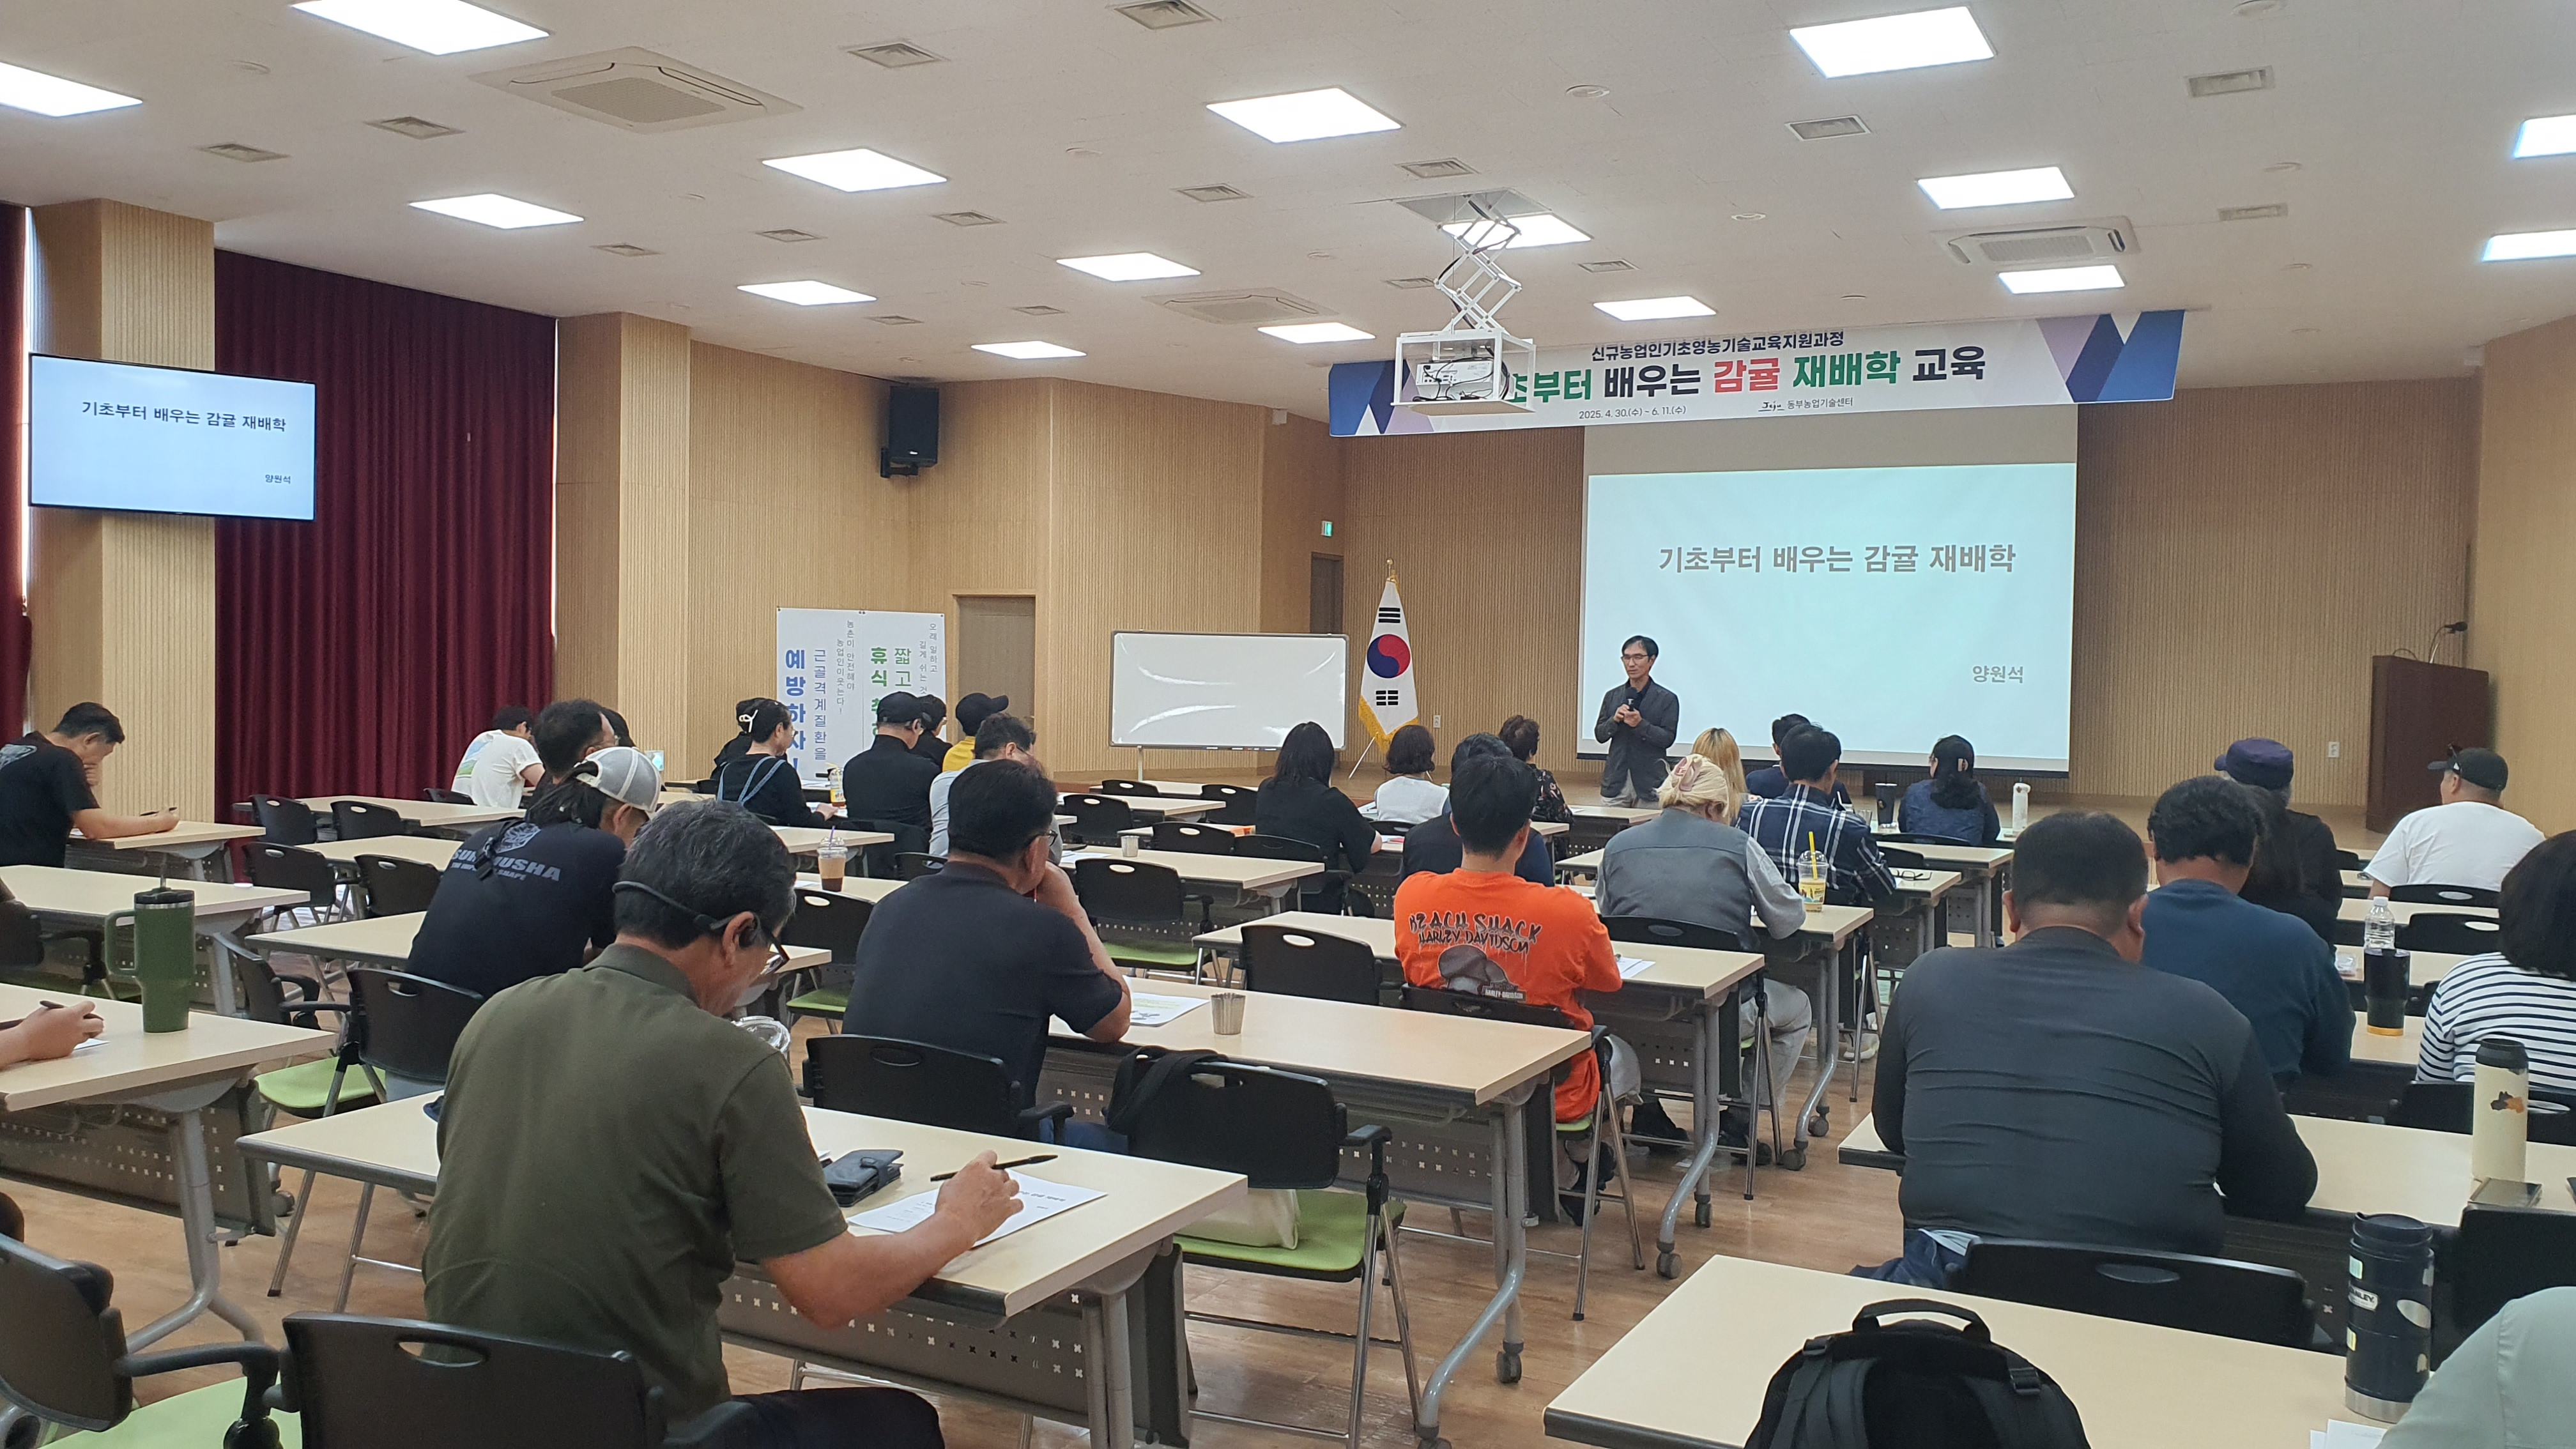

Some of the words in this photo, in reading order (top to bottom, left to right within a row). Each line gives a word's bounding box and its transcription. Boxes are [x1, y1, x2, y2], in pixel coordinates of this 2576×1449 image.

[1592, 331, 1843, 362] 신규농업인기초영농기술교육지원과정
[1604, 364, 1701, 397] 배우는
[1714, 358, 1780, 393] 감귤
[1793, 350, 1901, 387] 재배학
[1912, 346, 1985, 381] 교육
[82, 402, 146, 420] 기초부터
[153, 408, 200, 425] 배우는
[206, 412, 236, 428] 감귤
[242, 416, 286, 432] 재배학
[1579, 410, 1603, 418] 2025.
[1787, 397, 1853, 409] 동부농업기술센터
[265, 474, 291, 485] 양원석
[1659, 546, 1761, 573] 기초부터
[1773, 545, 1853, 573] 배우는
[1864, 544, 1919, 572] 감귤
[1929, 544, 2016, 572] 재배학
[871, 647, 887, 687] 휴식
[894, 648, 912, 687] 짧고
[1972, 665, 2025, 684] 양원석
[1409, 911, 1469, 932] BEACH
[1473, 913, 1542, 944] SHACK
[1419, 930, 1460, 944] HARLEY
[1466, 931, 1529, 954] DAVIDSON
